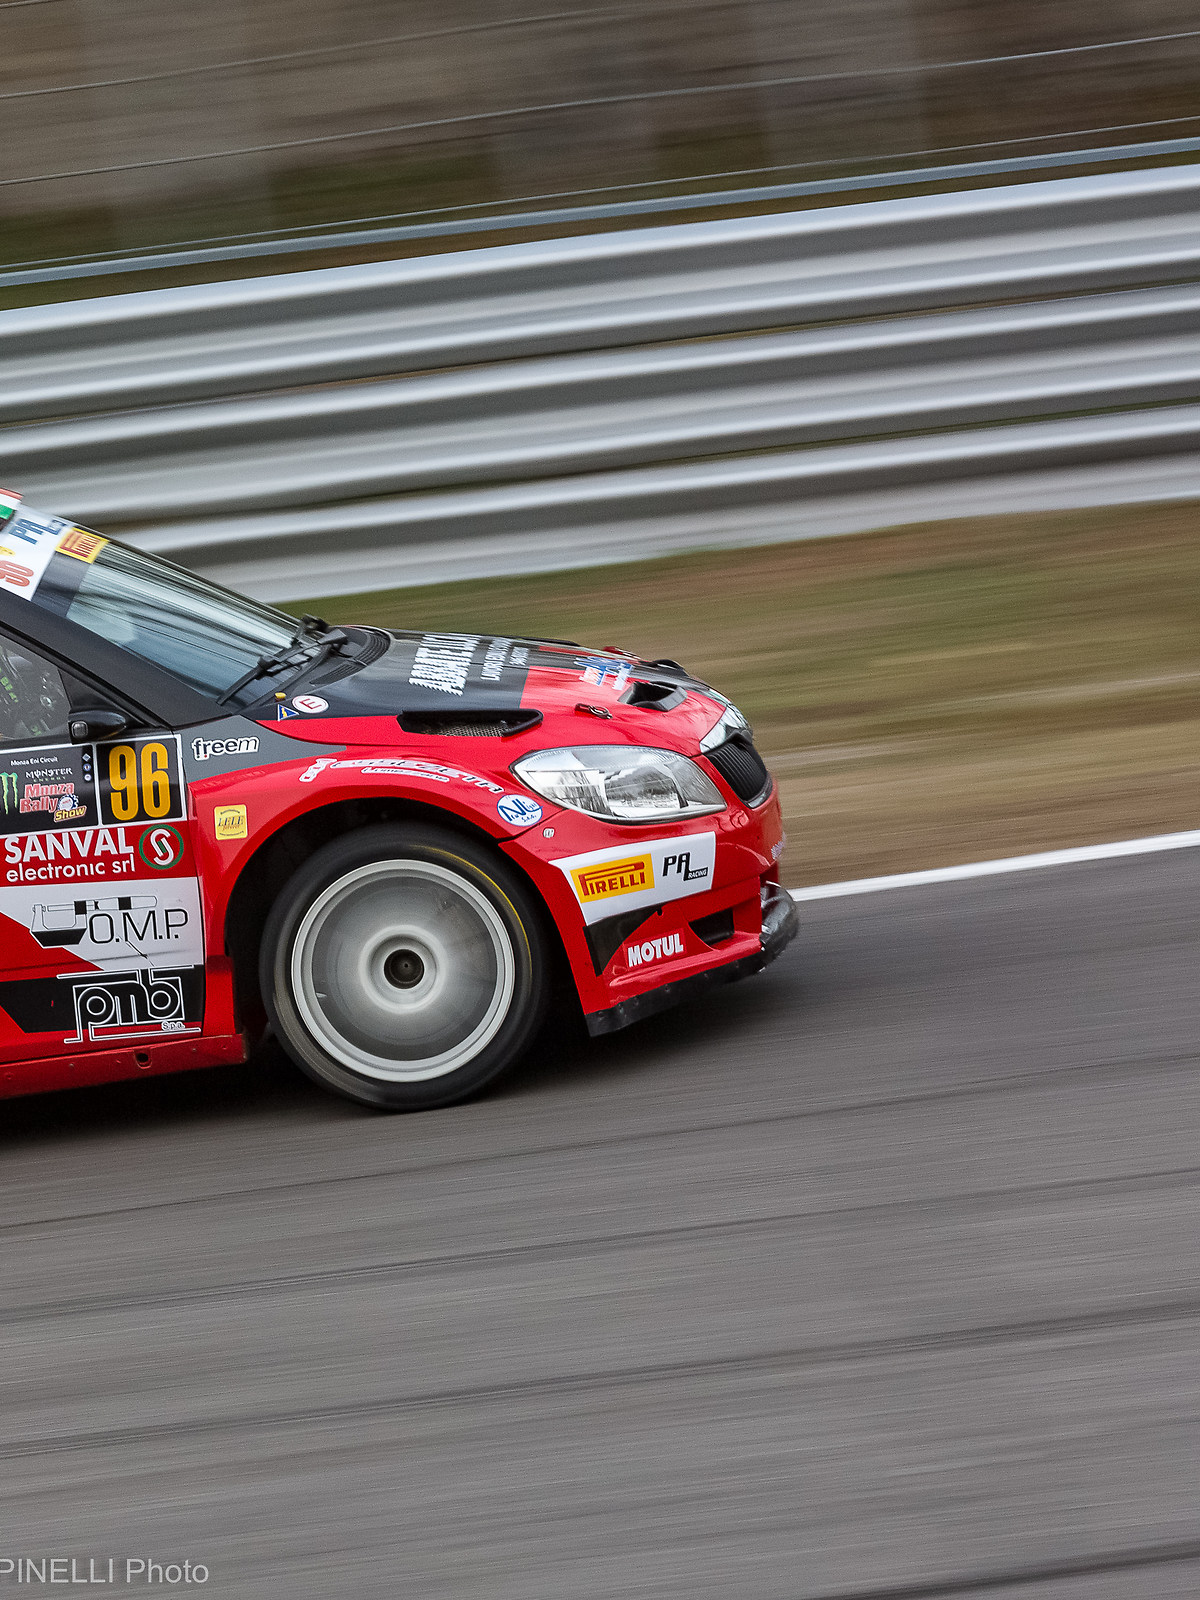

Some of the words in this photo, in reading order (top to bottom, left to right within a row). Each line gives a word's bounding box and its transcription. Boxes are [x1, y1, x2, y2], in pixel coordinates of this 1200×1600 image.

[193, 739, 258, 759] freem
[25, 767, 73, 779] MONSTER
[108, 742, 171, 821] 96
[24, 783, 74, 798] Monza
[20, 796, 58, 813] Rally
[55, 807, 86, 820] Show
[4, 827, 134, 864] SANVAL
[6, 863, 105, 883] electronic
[112, 854, 135, 874] srl
[578, 861, 645, 896] PIRELLI
[687, 869, 708, 879] RACING
[627, 933, 684, 967] MOTUL
